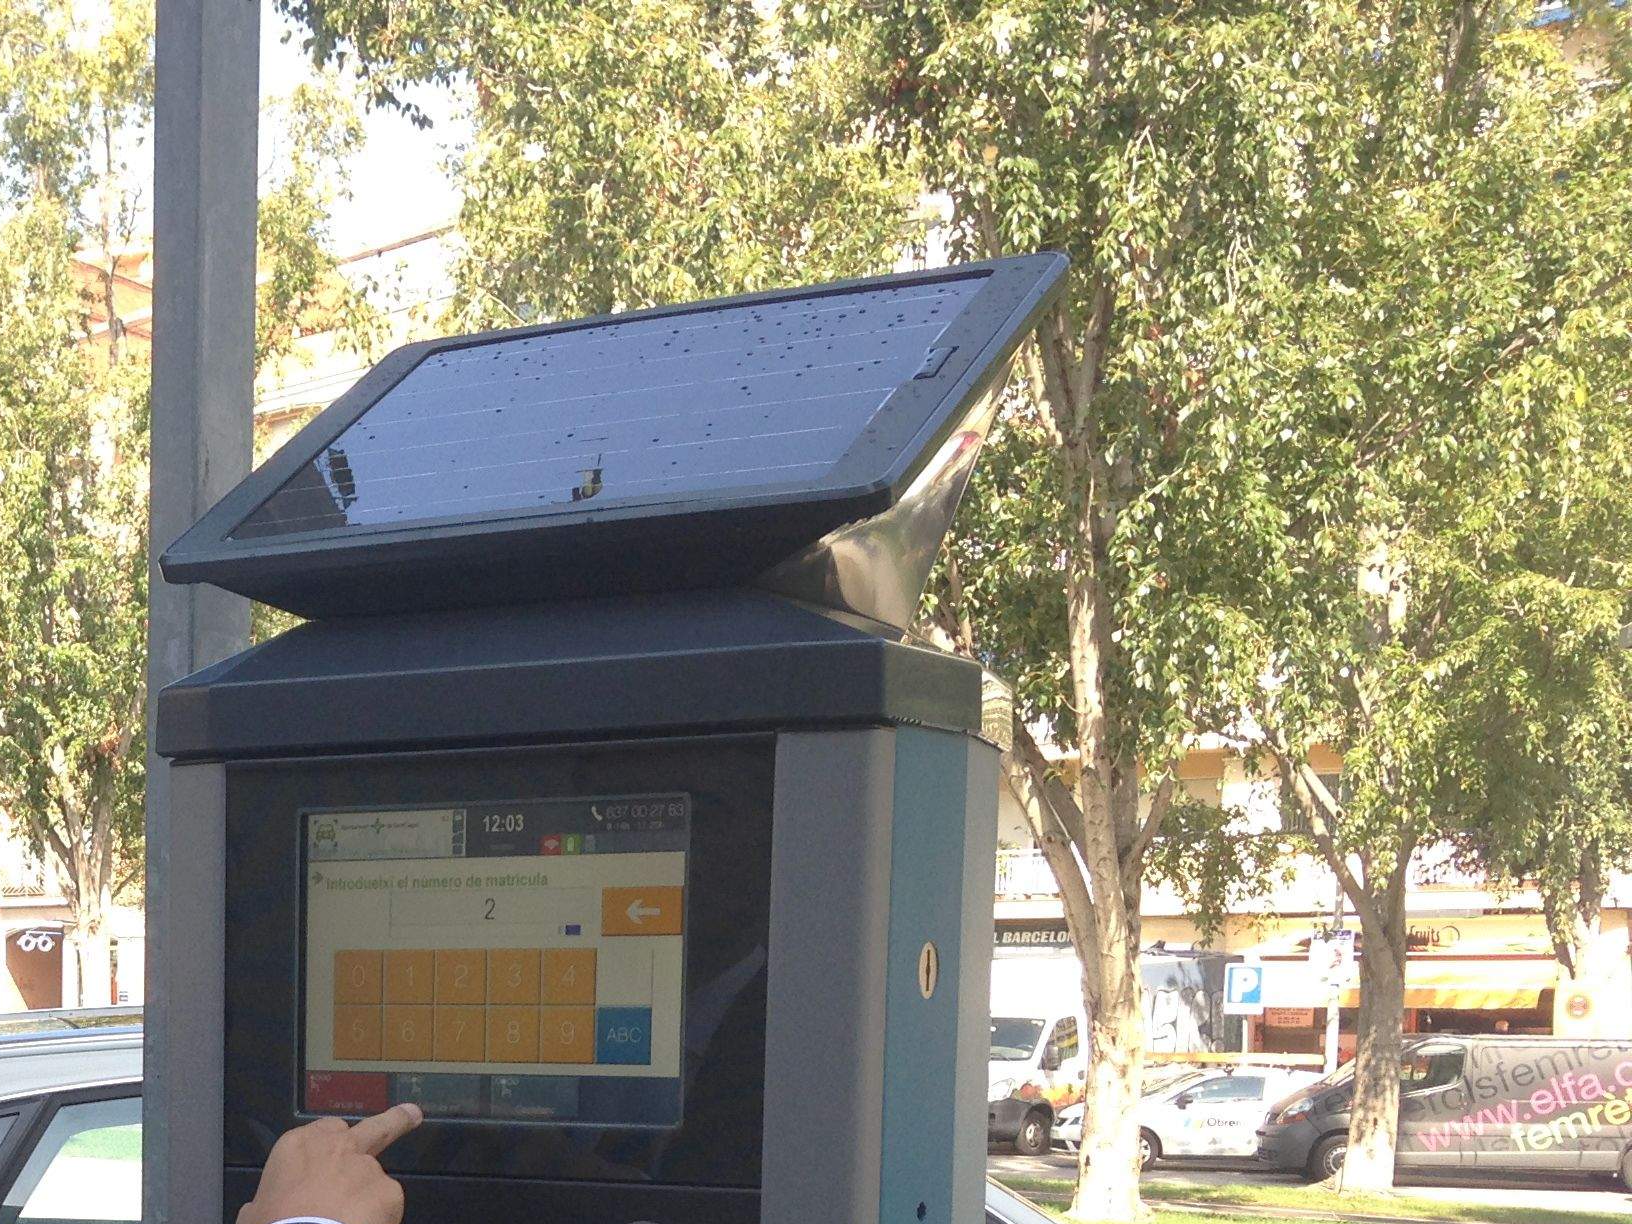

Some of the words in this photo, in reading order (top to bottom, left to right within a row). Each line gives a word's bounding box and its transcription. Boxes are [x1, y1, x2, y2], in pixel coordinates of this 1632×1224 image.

[482, 814, 524, 832] 12:03
[397, 875, 409, 889] el
[465, 873, 483, 888] de
[483, 897, 496, 920] 2
[352, 964, 365, 988] 0
[406, 964, 415, 987] 1
[454, 964, 468, 987] 2
[507, 964, 522, 988] 3
[561, 964, 577, 988] 4
[1231, 967, 1259, 1003] P
[401, 1019, 415, 1043] 6
[454, 1020, 467, 1043] 7
[507, 1020, 521, 1045] 8
[559, 1020, 575, 1045] 9
[606, 1026, 643, 1044] ABC
